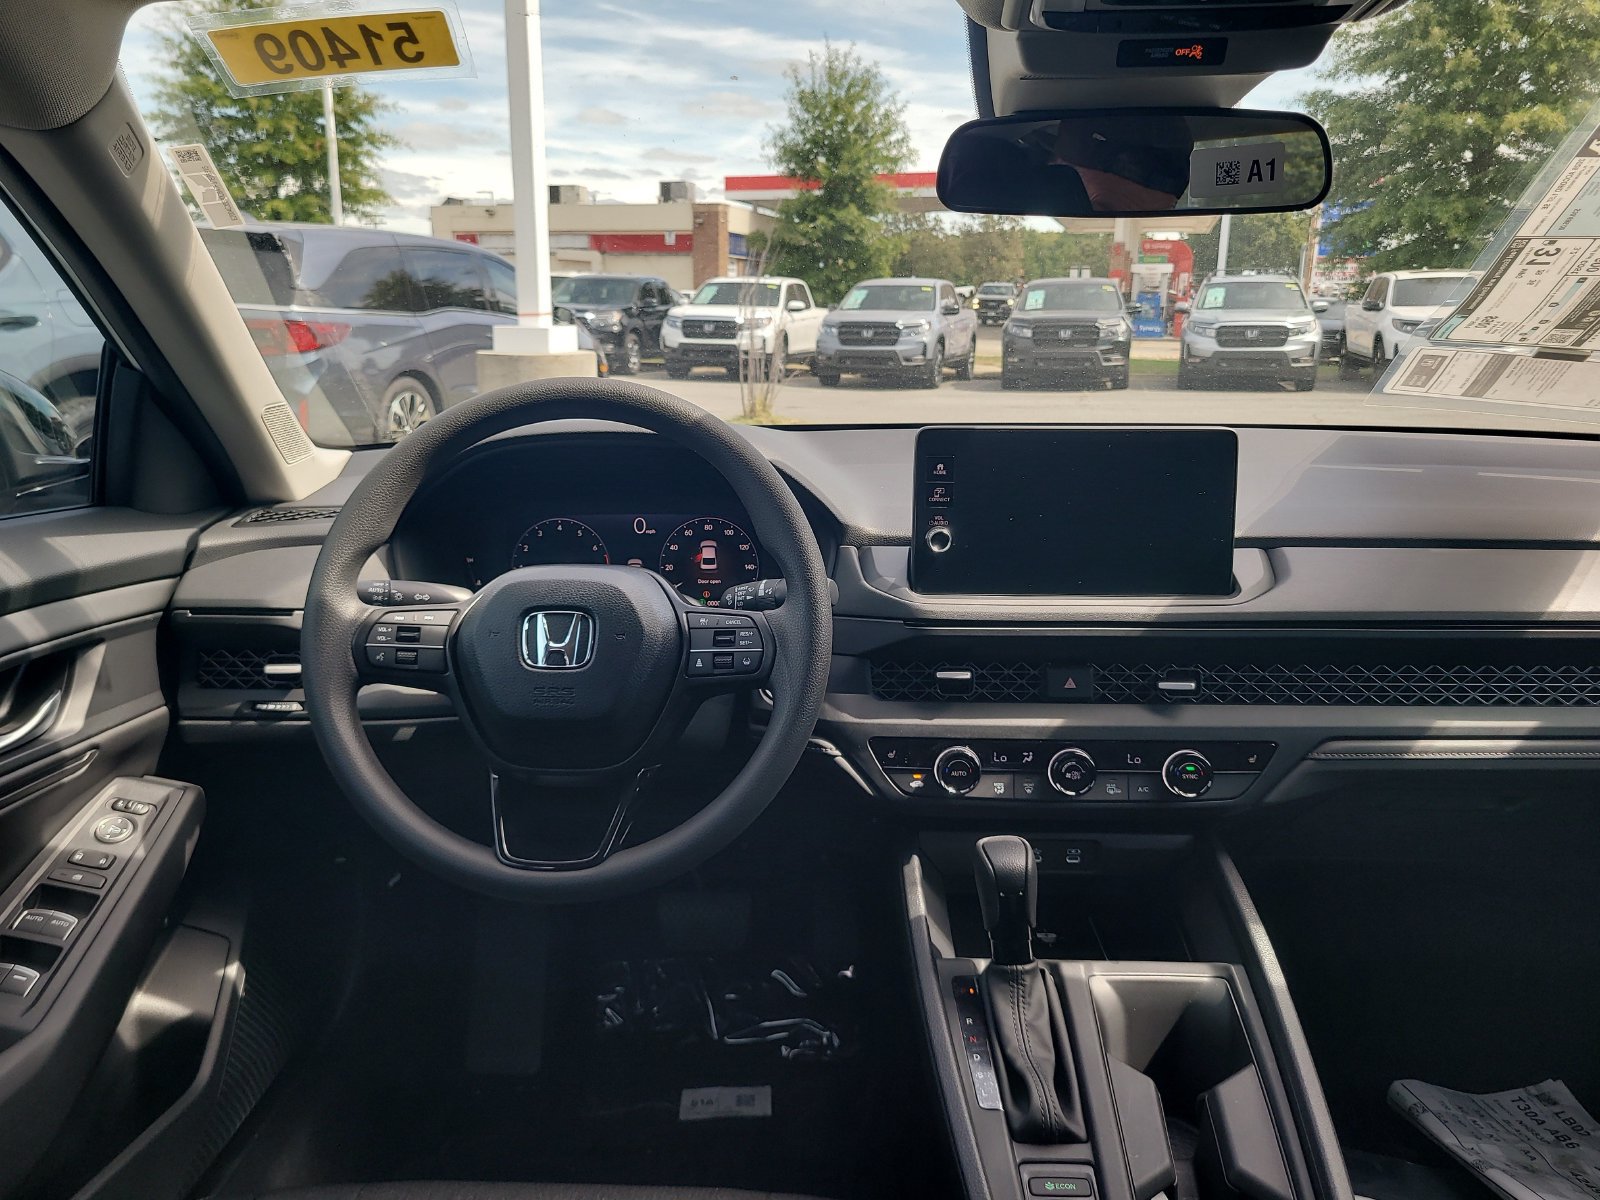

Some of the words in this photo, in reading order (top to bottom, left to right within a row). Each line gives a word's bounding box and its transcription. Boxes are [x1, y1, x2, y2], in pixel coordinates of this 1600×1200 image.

[1175, 48, 1191, 56] OFF
[1246, 157, 1276, 183] A1
[634, 517, 646, 534] 0
[994, 752, 1008, 762] Lo
[1127, 754, 1142, 764] Lo
[1511, 1096, 1546, 1126] T30A
